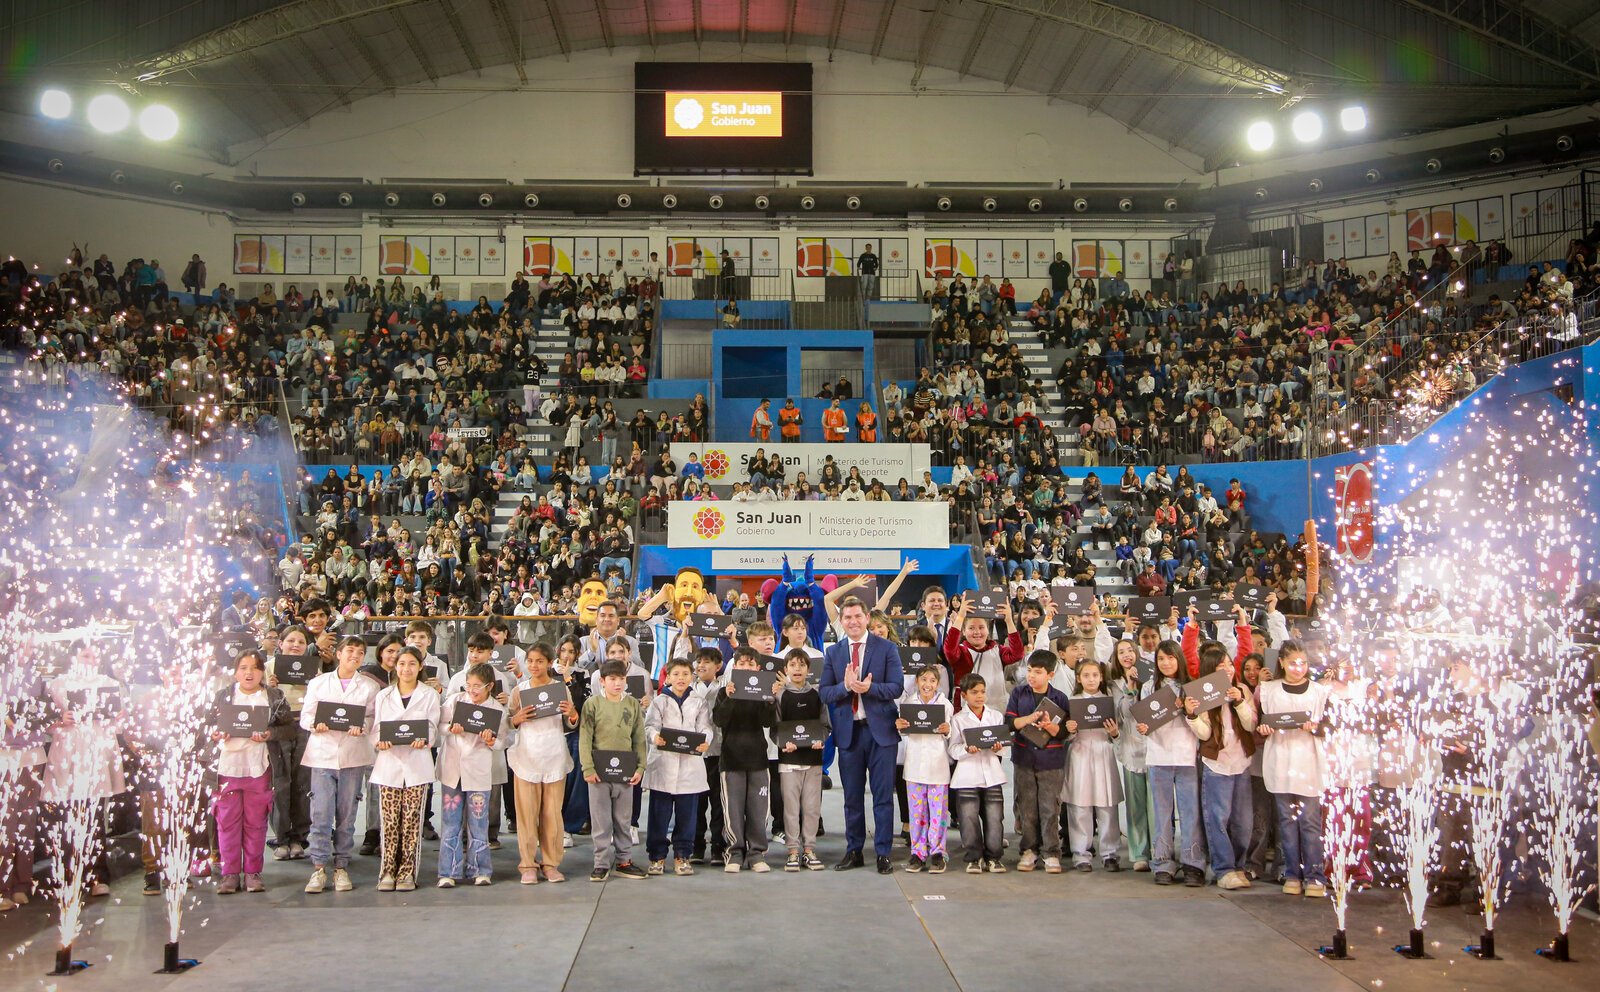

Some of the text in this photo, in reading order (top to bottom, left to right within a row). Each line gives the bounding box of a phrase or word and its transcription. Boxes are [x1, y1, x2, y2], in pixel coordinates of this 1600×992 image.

[712, 102, 772, 114] San Juan
[712, 116, 756, 126] Gobierno
[527, 370, 539, 379] 23
[736, 512, 801, 523] San Juan
[819, 516, 913, 525] Ministerio de Turismo
[819, 528, 850, 536] Cultura
[860, 528, 896, 537] Deporte
